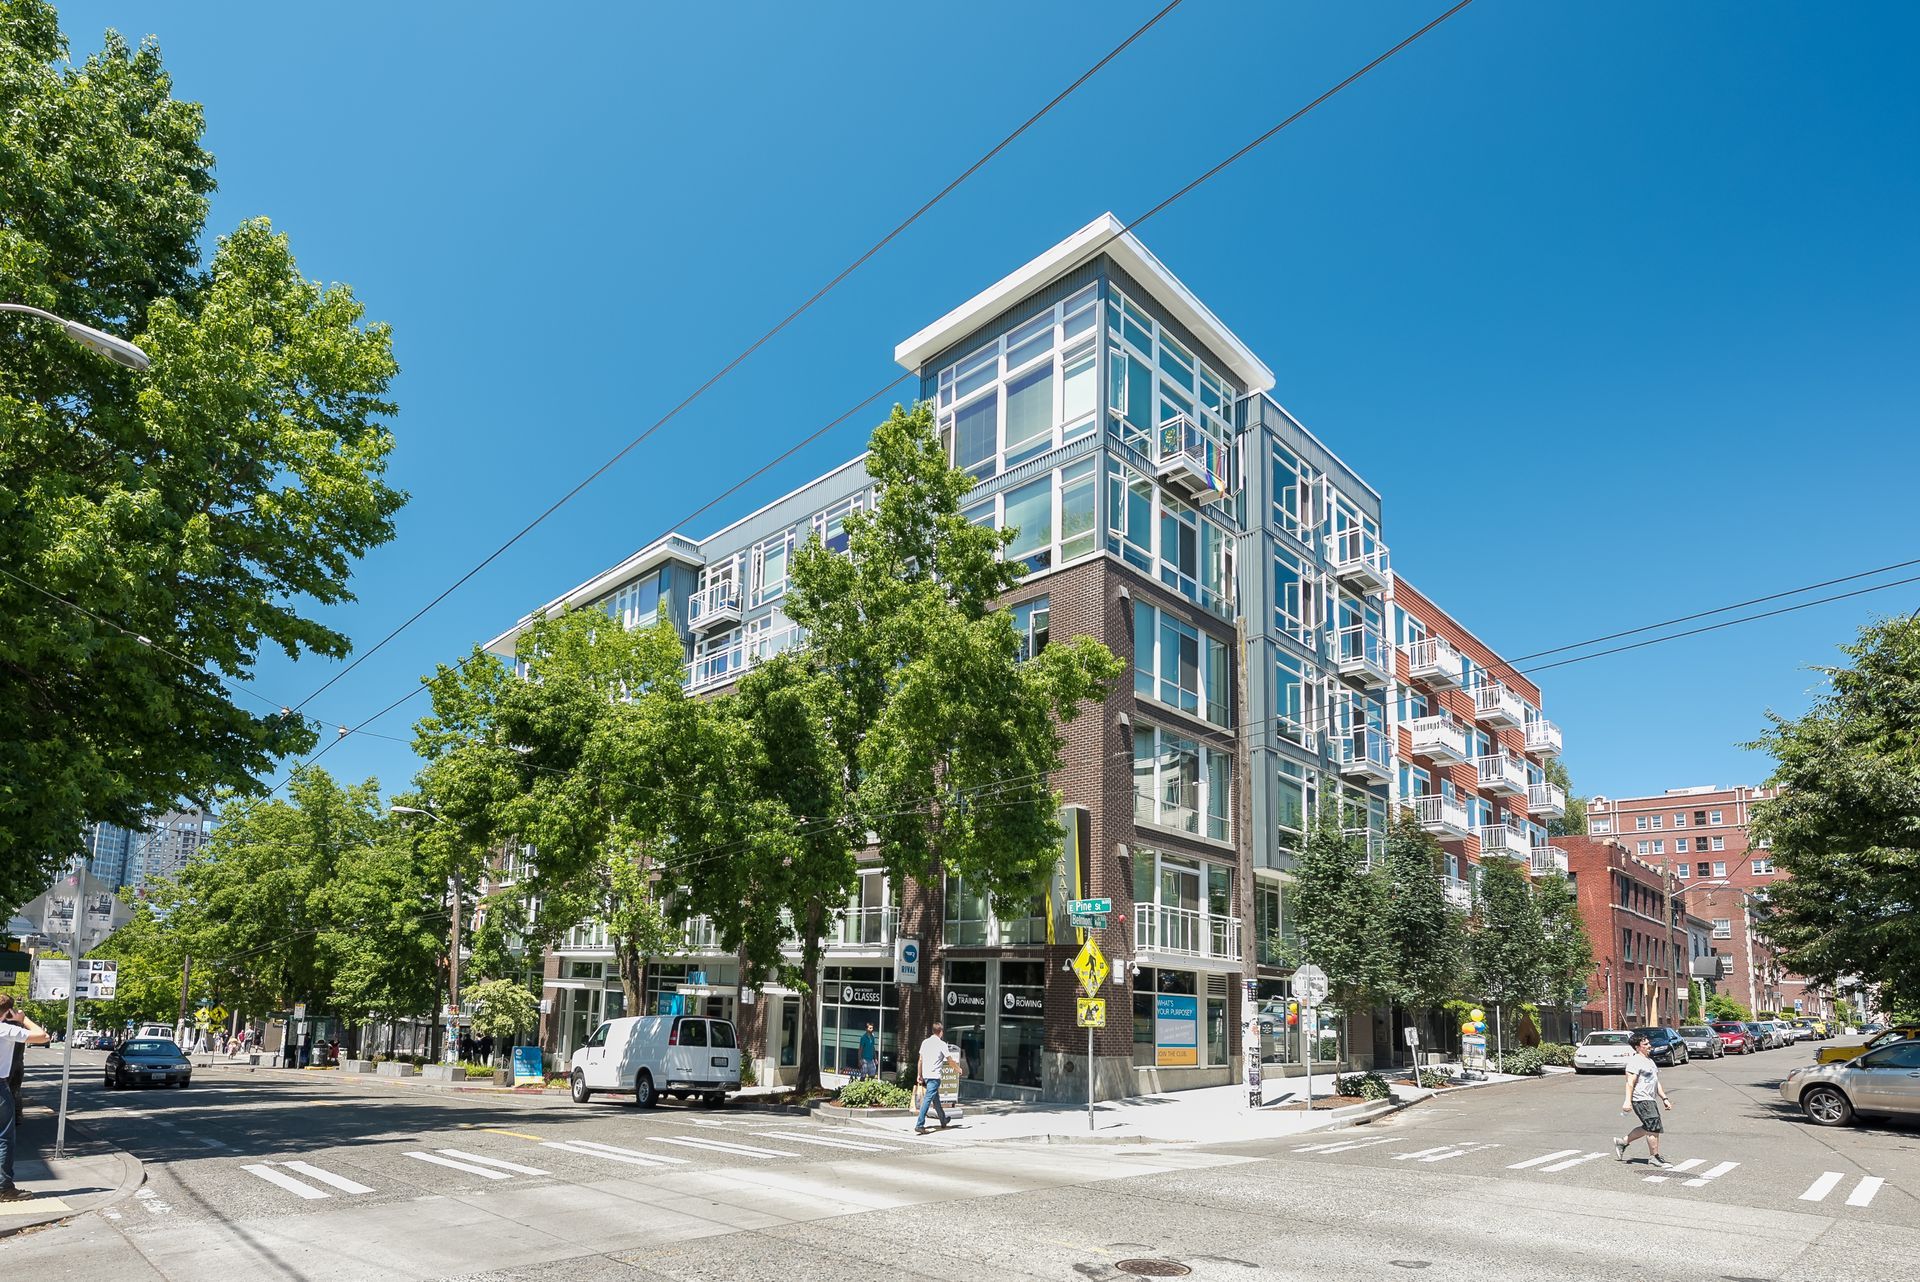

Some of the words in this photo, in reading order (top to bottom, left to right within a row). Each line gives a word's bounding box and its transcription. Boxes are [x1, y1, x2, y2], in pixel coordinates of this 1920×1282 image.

[1070, 904, 1074, 912] E
[1076, 901, 1092, 911] Pine
[1094, 902, 1101, 911] St
[901, 965, 916, 974] RIVAL
[854, 992, 880, 1002] CLASSES
[957, 996, 985, 1005] TRAINING
[1015, 999, 1043, 1008] ROWING
